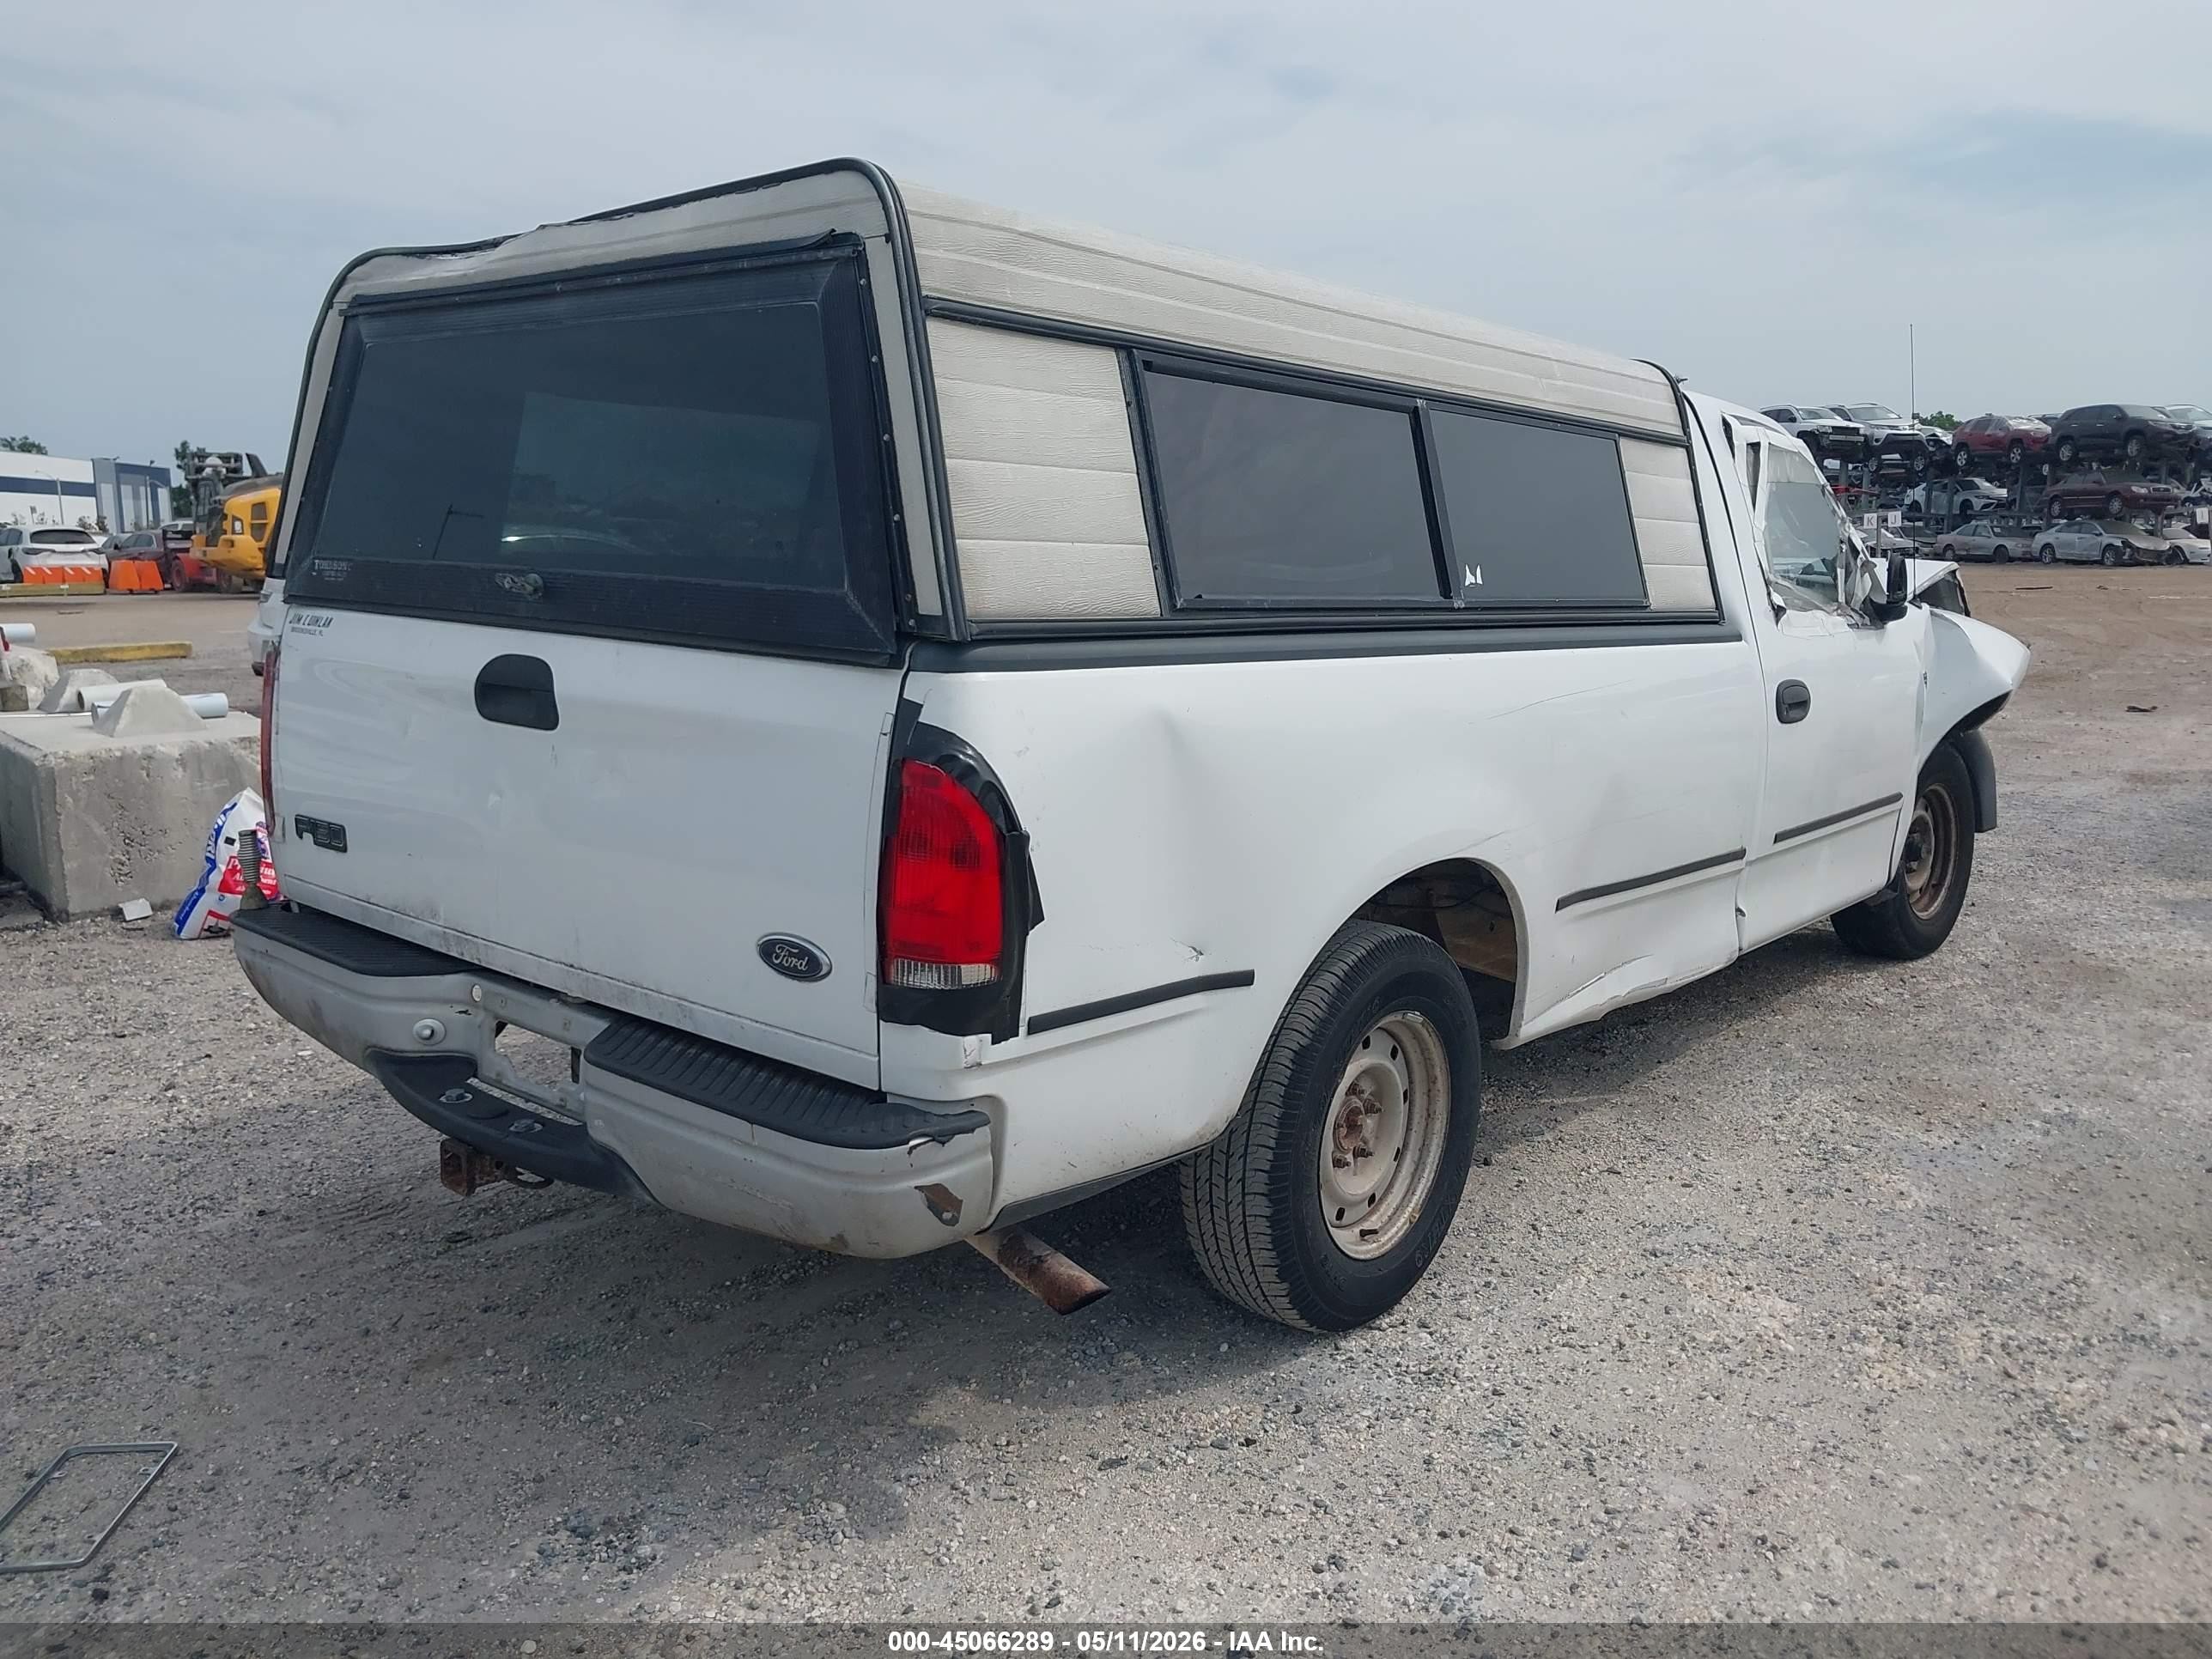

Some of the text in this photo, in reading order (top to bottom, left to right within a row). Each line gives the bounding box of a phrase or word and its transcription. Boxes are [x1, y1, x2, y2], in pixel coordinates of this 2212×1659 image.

[1867, 516, 1875, 526] K
[1891, 514, 1898, 525] J
[772, 944, 809, 971] Ford
